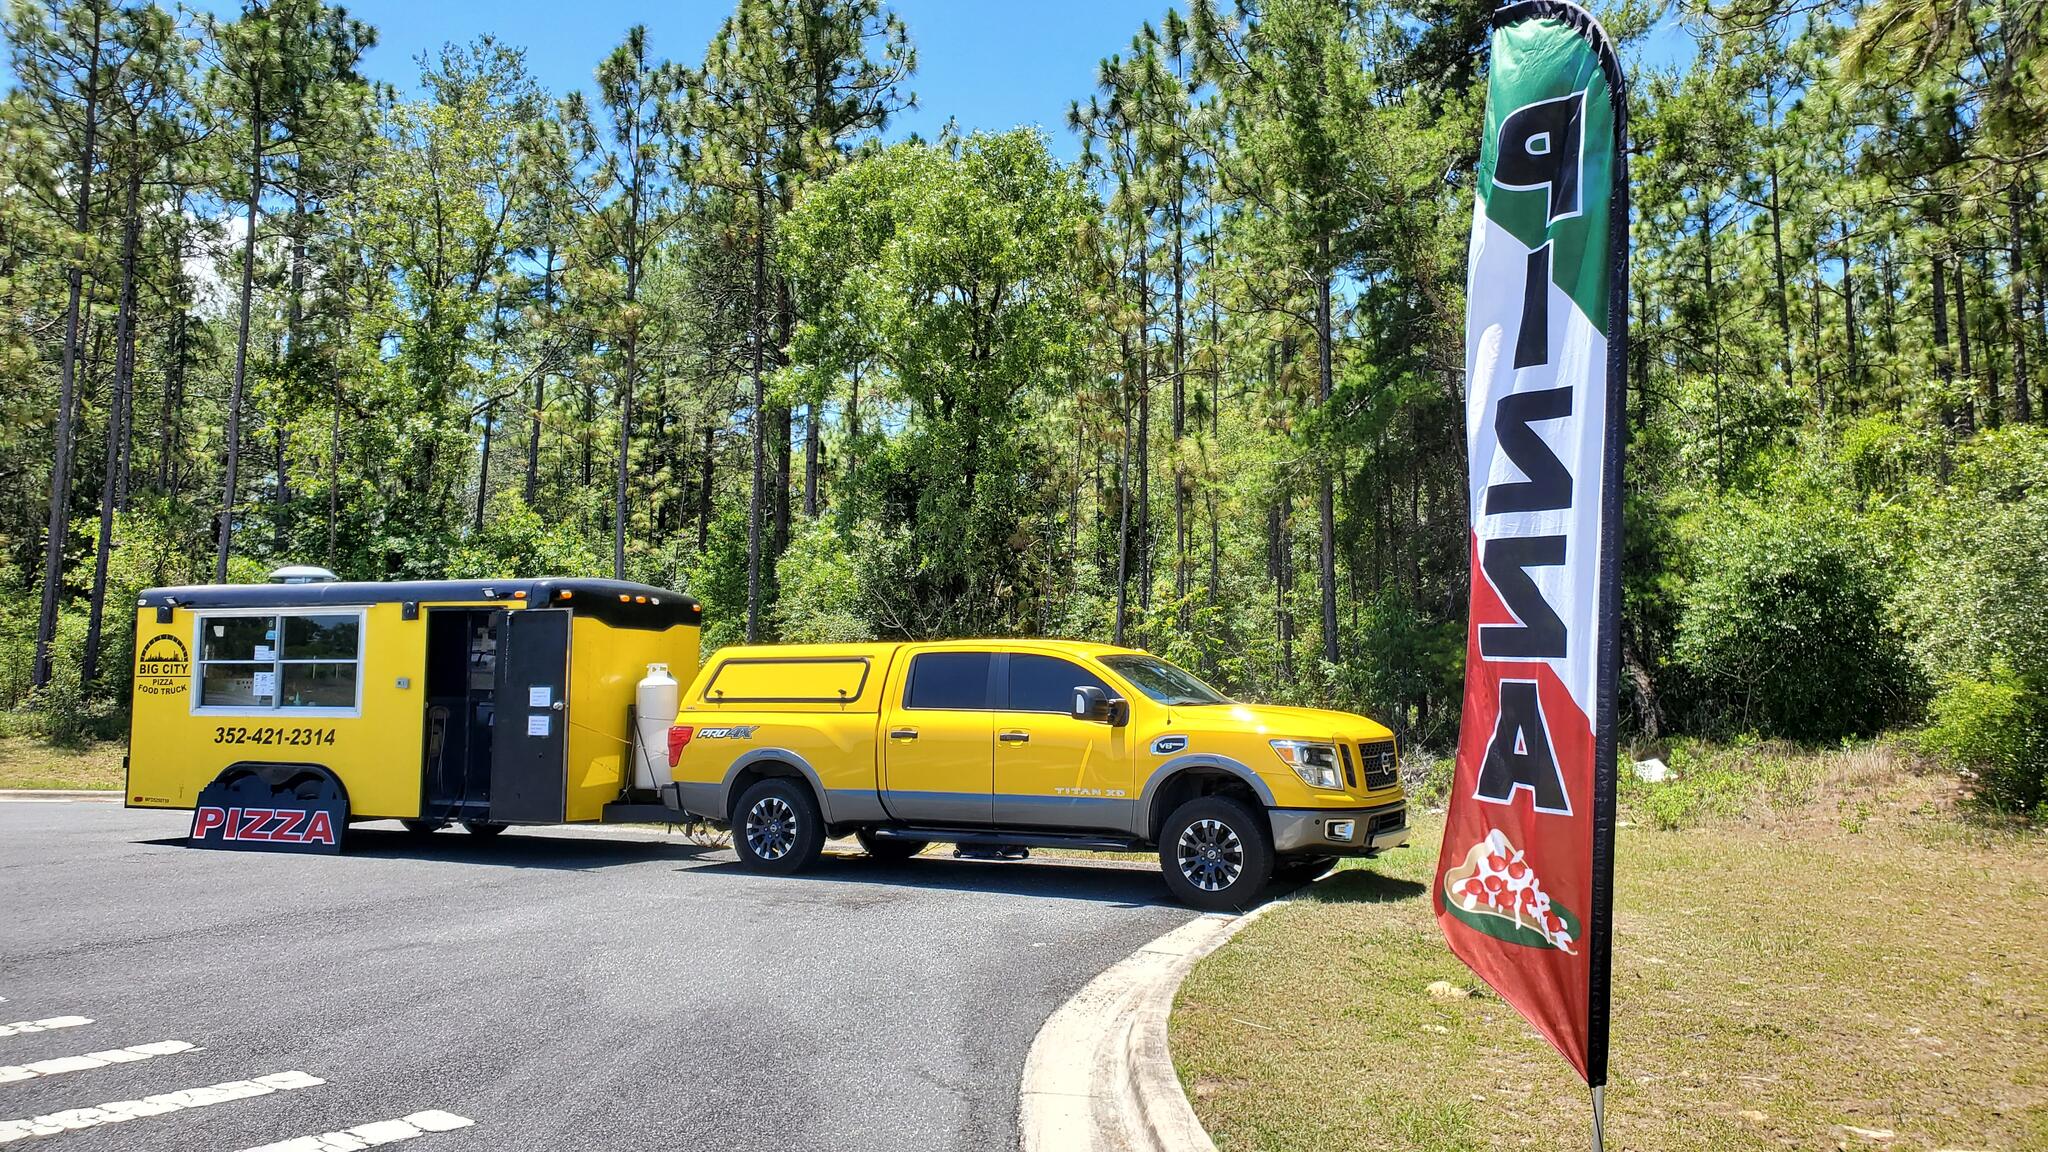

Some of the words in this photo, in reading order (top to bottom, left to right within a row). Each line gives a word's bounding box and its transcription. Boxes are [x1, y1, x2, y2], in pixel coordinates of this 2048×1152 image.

[140, 664, 159, 674] BIG
[162, 664, 188, 674] CITY
[138, 684, 159, 695] FOOD
[160, 684, 187, 695] TRUCK
[214, 727, 336, 746] 352-421-2314
[1054, 787, 1102, 796] TITAN
[1105, 789, 1126, 797] XD
[192, 806, 336, 845] PIZZA
